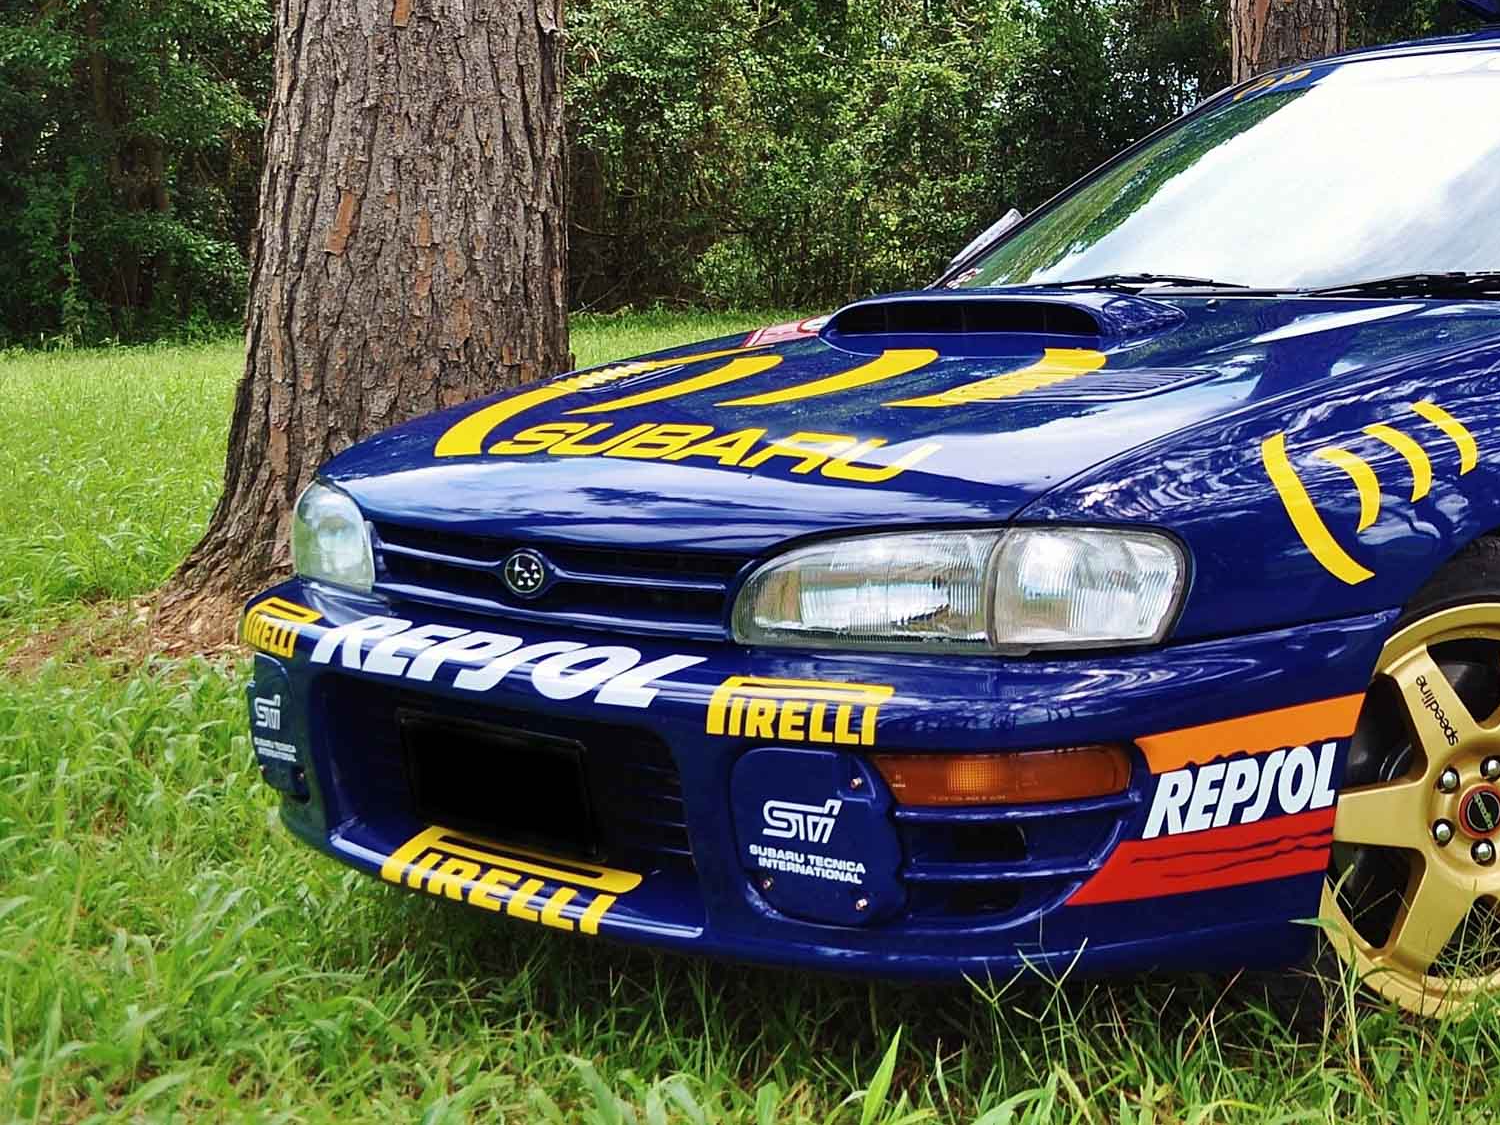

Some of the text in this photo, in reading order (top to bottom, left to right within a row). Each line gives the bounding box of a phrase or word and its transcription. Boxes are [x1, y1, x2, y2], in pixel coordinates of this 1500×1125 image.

[488, 422, 943, 483] SUBARU
[310, 615, 708, 708] REPSOL
[706, 675, 895, 746] PIRELLI
[1416, 675, 1459, 746] speedline
[1142, 742, 1336, 840] REPSOL
[381, 825, 642, 935] PIRELLI
[749, 844, 866, 874] SUBARU TECNICA
[758, 857, 863, 884] INTERNATIONAL
